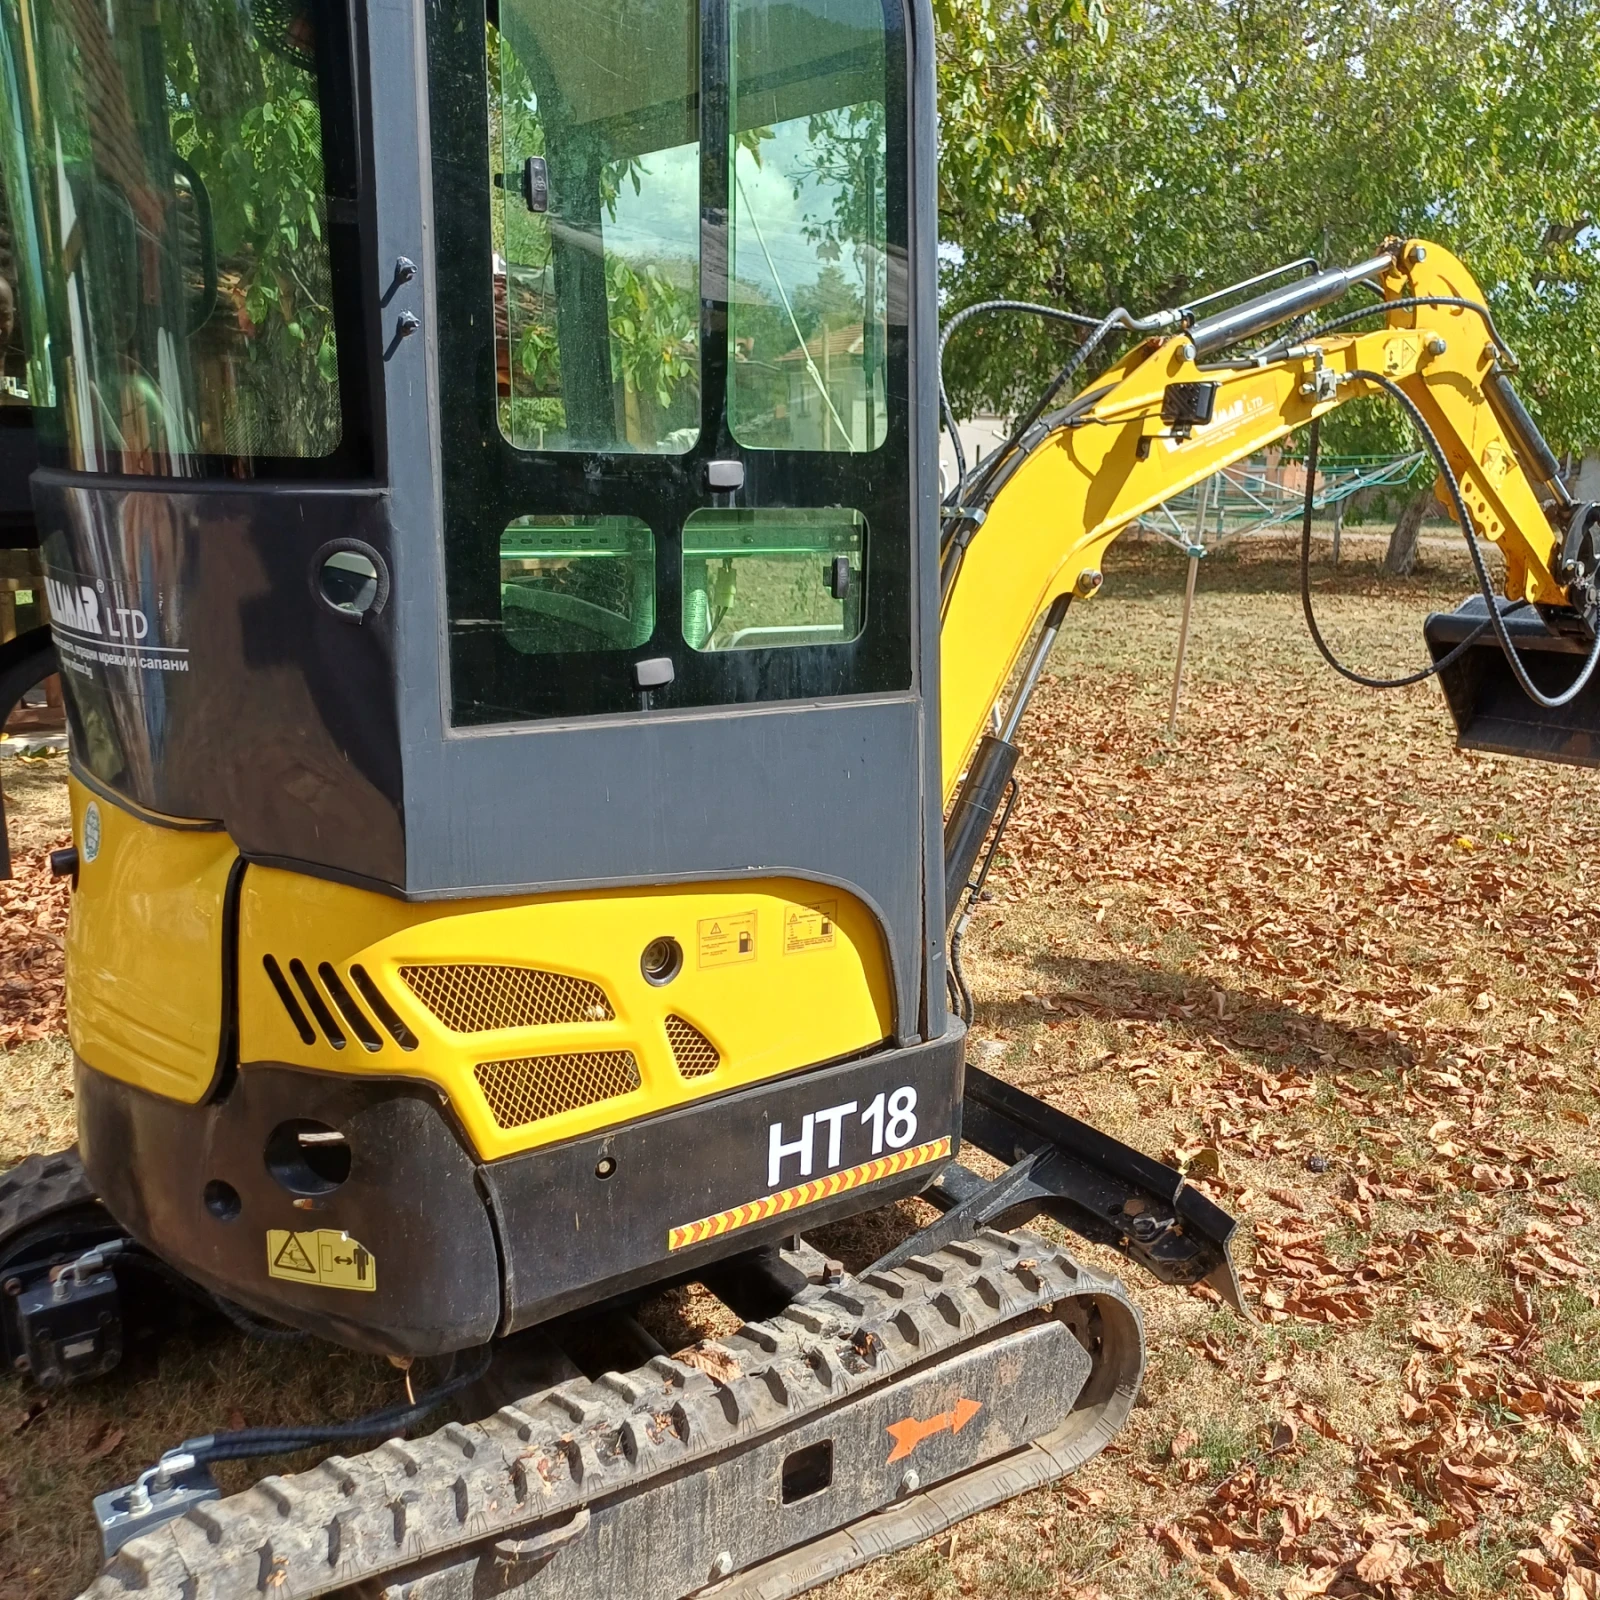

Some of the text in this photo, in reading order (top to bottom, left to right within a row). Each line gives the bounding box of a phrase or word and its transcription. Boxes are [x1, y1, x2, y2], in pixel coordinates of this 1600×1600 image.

[106, 607, 149, 639] LTD
[98, 651, 128, 666] мрежи
[128, 656, 137, 667] и
[139, 657, 189, 671] сапани
